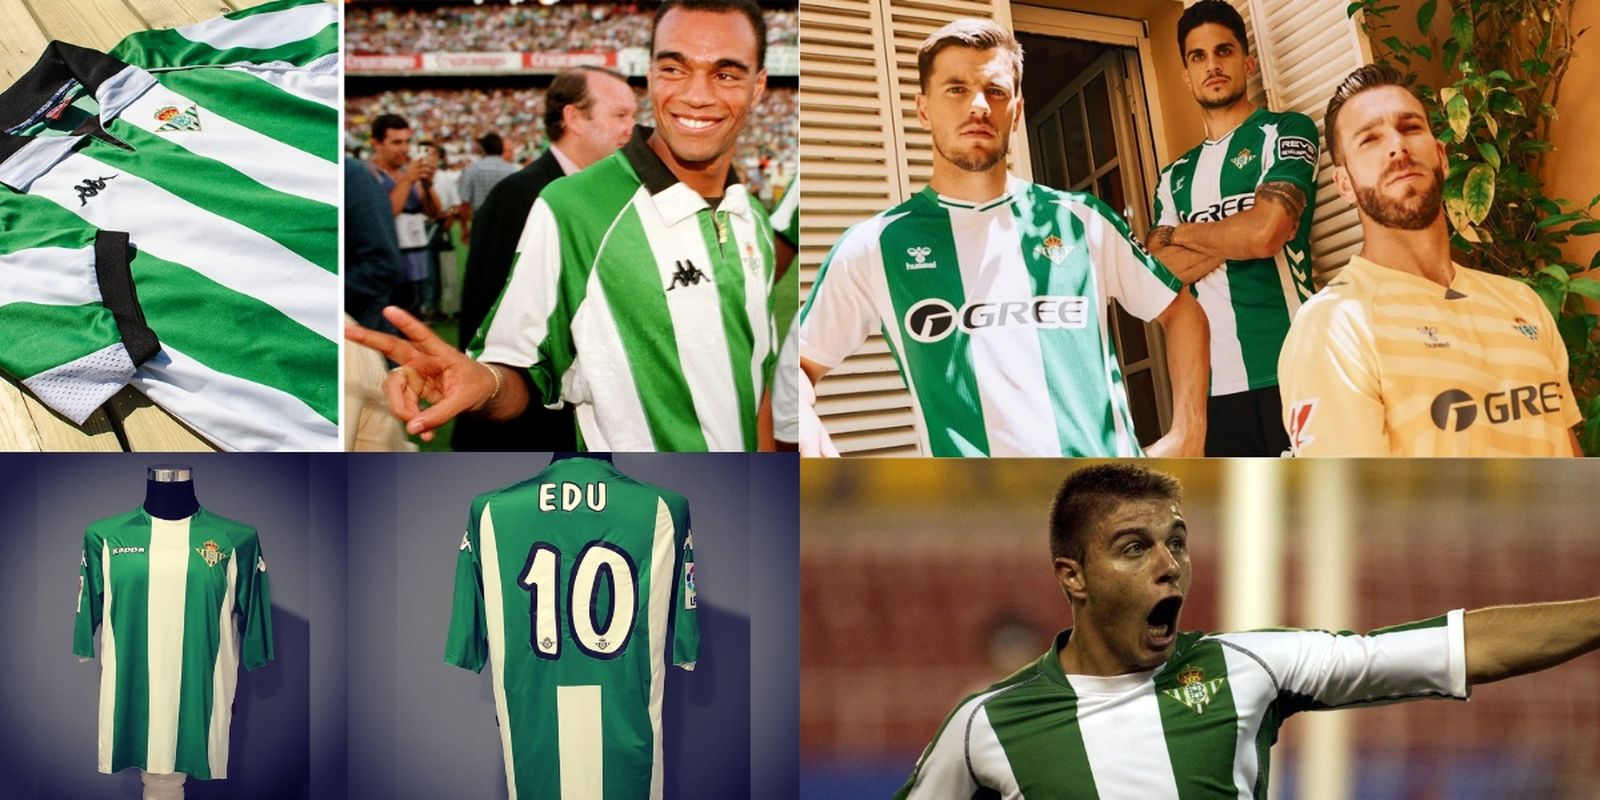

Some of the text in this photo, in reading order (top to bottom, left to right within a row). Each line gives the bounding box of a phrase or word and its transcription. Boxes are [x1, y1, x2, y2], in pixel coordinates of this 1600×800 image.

[962, 300, 1083, 329] GREE
[1484, 381, 1563, 425] GRE
[539, 482, 607, 512] EDU
[518, 541, 639, 660] 10
